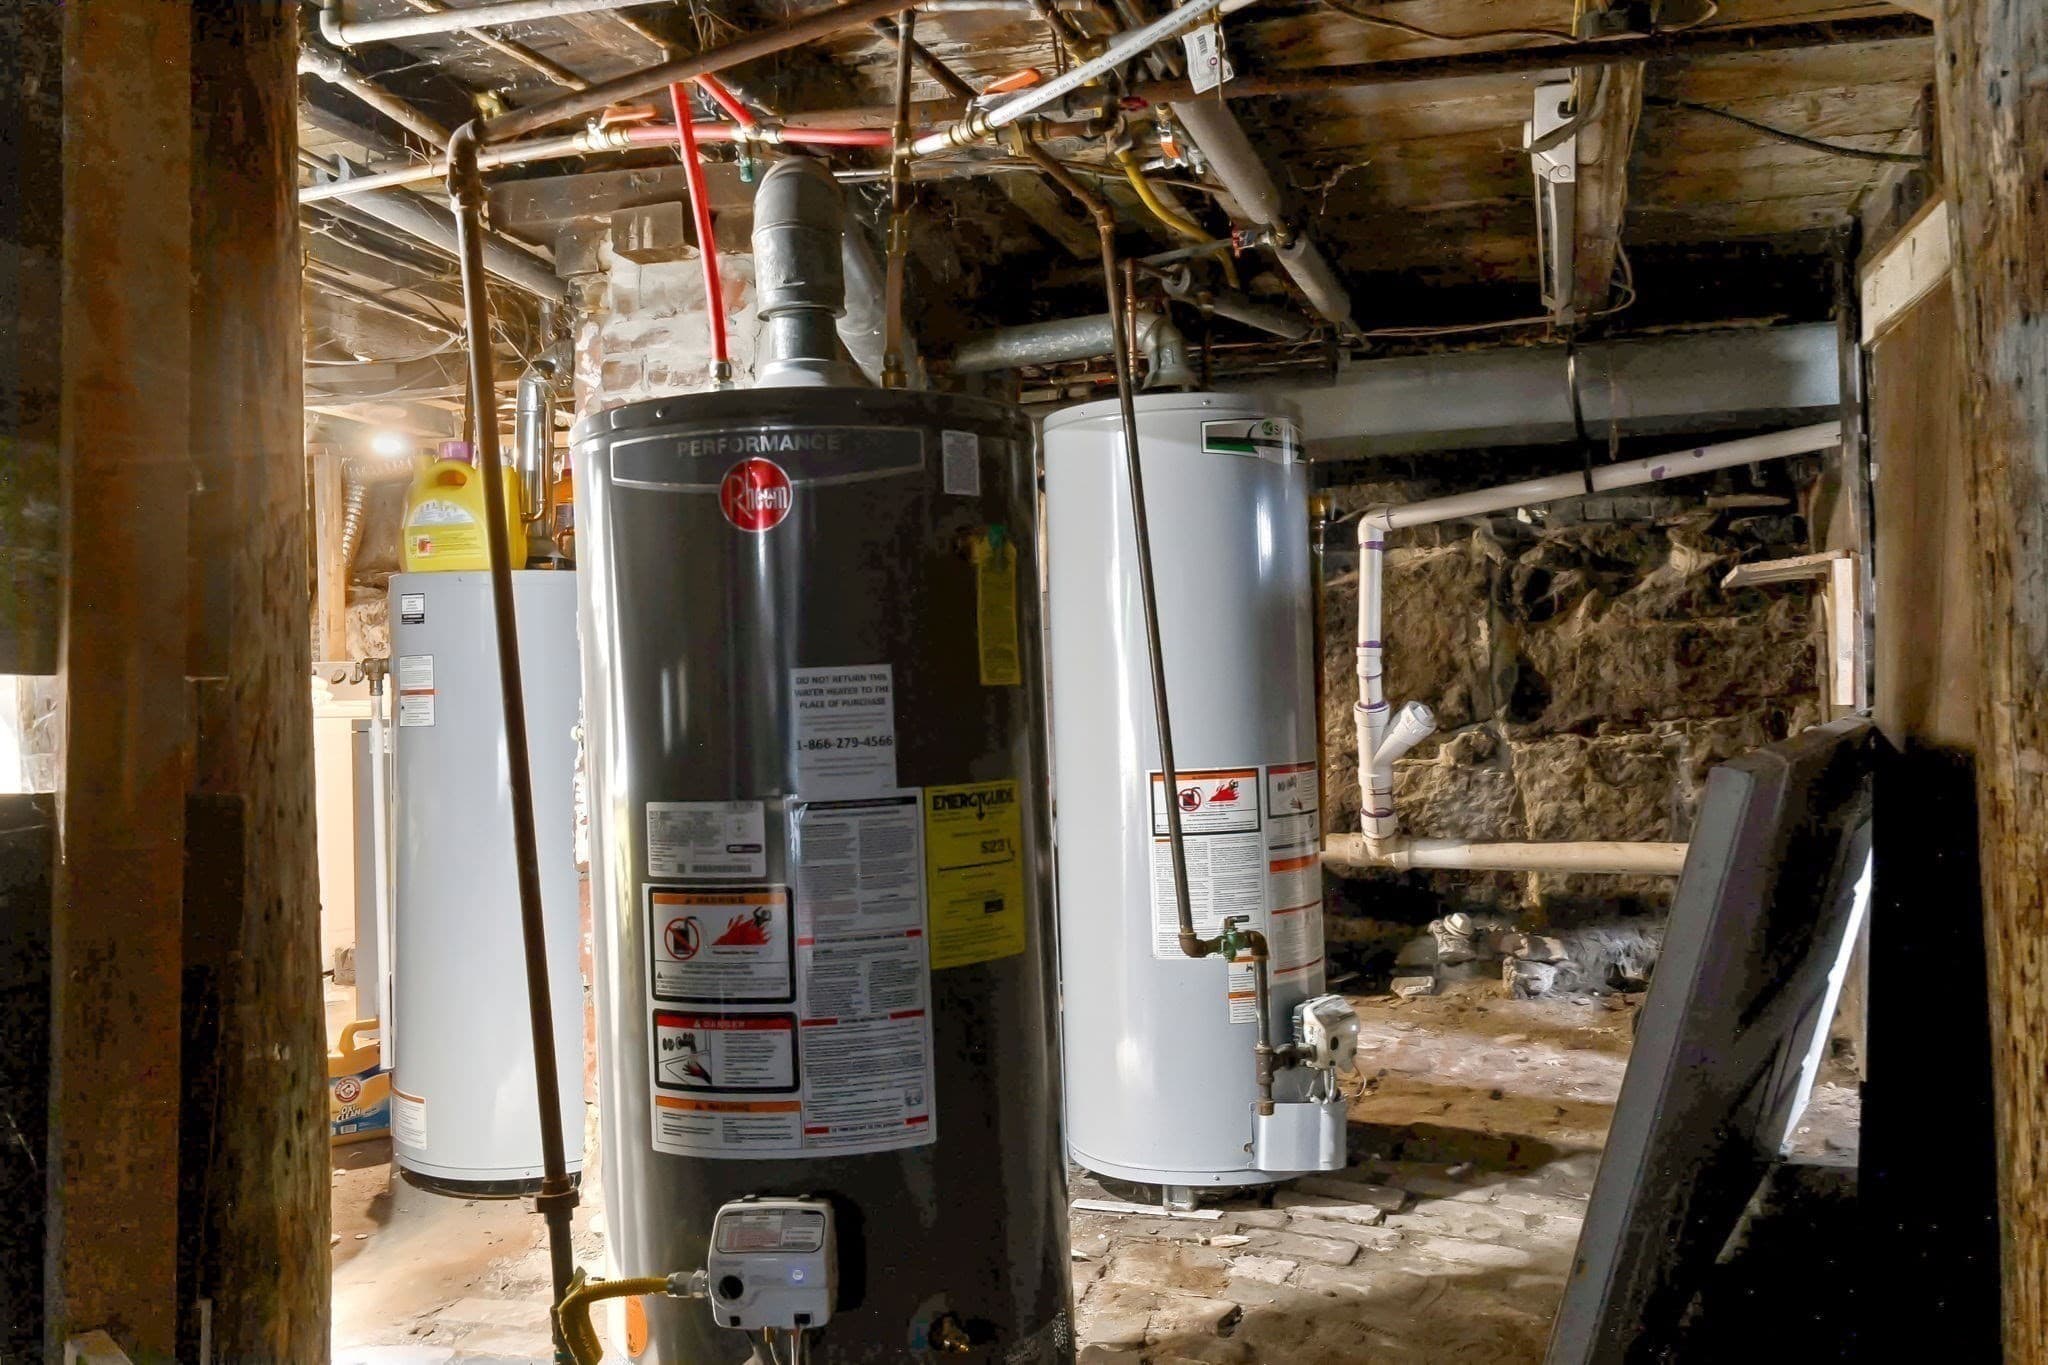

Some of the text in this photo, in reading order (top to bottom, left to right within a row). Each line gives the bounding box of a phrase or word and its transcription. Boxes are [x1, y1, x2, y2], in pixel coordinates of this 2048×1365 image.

[677, 433, 841, 457] PERFORMANCE
[727, 461, 788, 521] Rheem
[795, 677, 810, 685] DO
[812, 675, 829, 684] NOT
[833, 674, 866, 684] RETURN
[794, 688, 824, 697] WATER
[826, 687, 858, 696] HEATER
[861, 686, 873, 694] TO
[799, 697, 886, 709] PLACE OF PURCHASE
